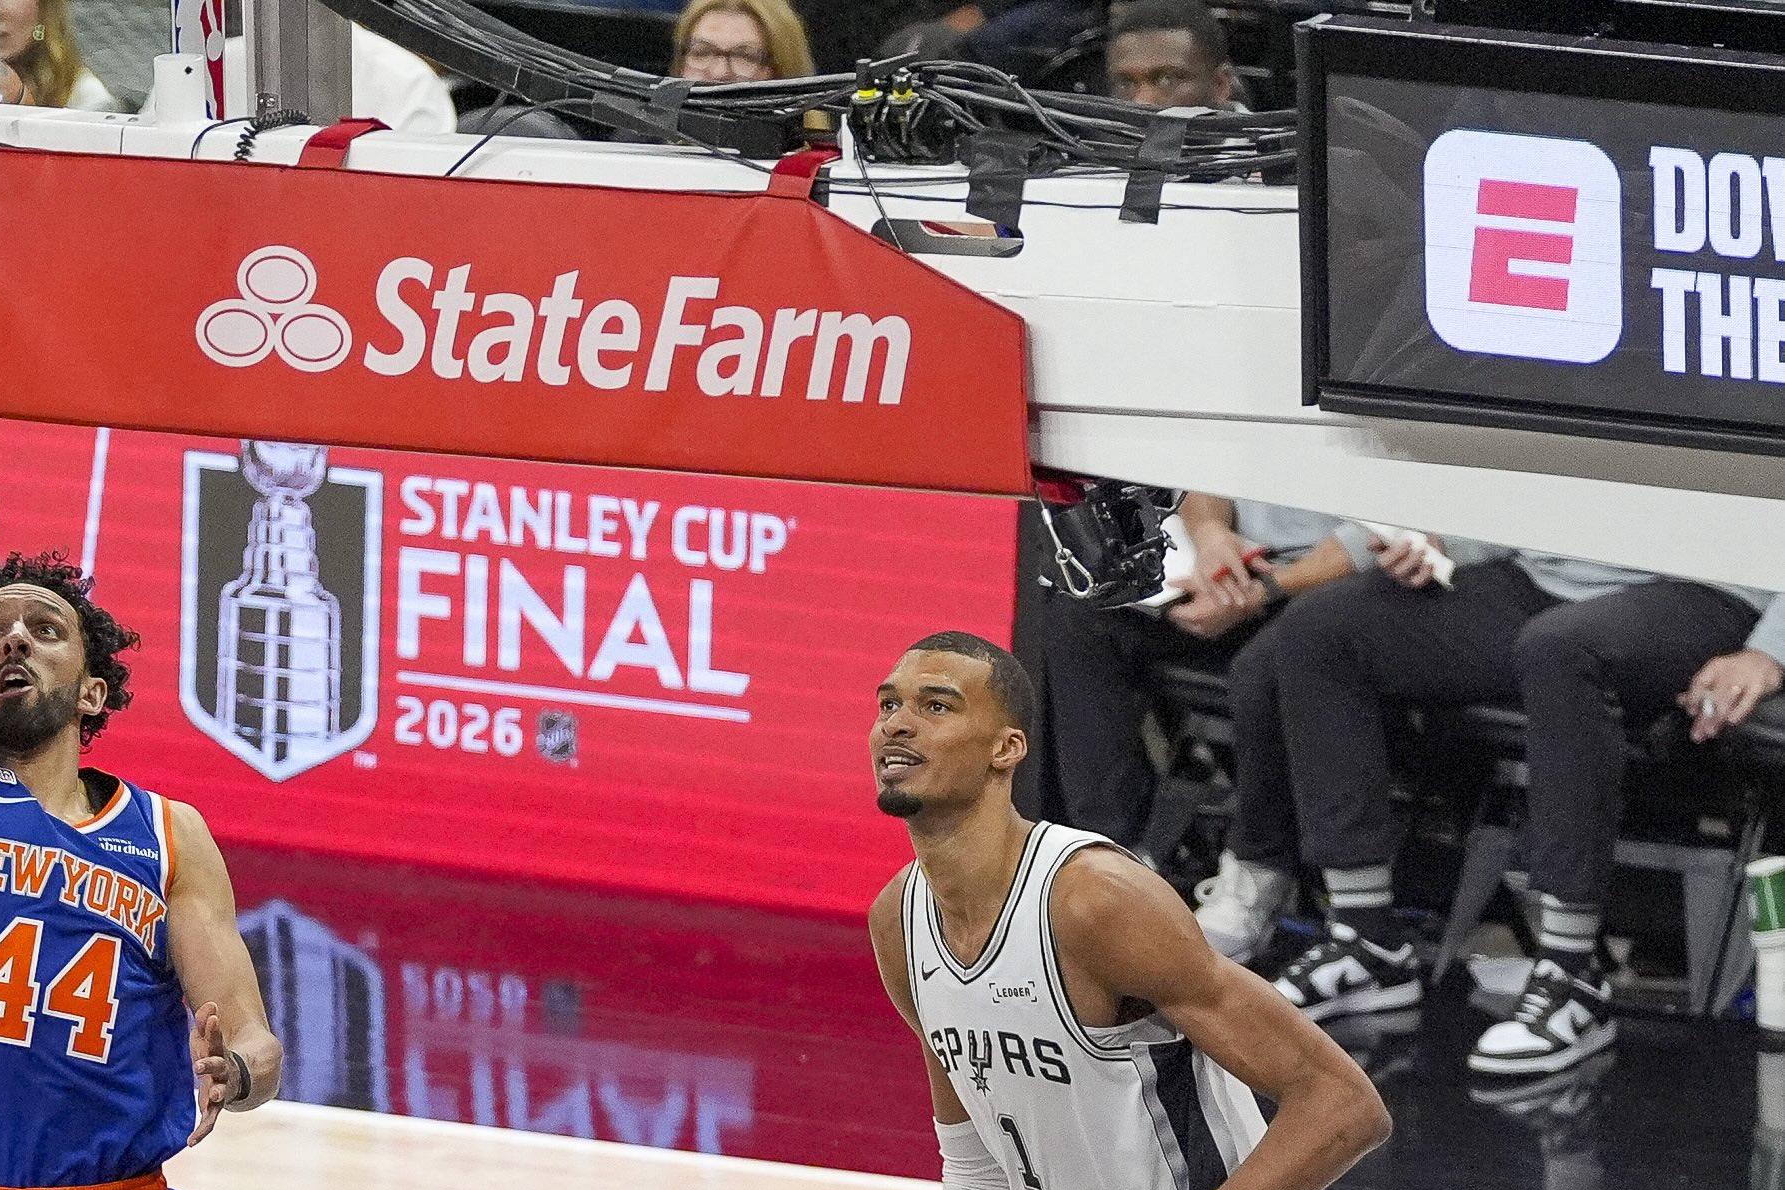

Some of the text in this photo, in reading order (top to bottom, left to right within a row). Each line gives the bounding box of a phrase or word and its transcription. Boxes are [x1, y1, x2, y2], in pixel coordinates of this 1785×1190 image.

[1648, 145, 1785, 262] DO
[1651, 267, 1785, 384] THE
[399, 475, 661, 561] STANLEY
[396, 545, 751, 697] FINAL
[394, 695, 524, 757] 2026
[60, 854, 168, 960] YORK
[996, 987, 1032, 998] LEDGER
